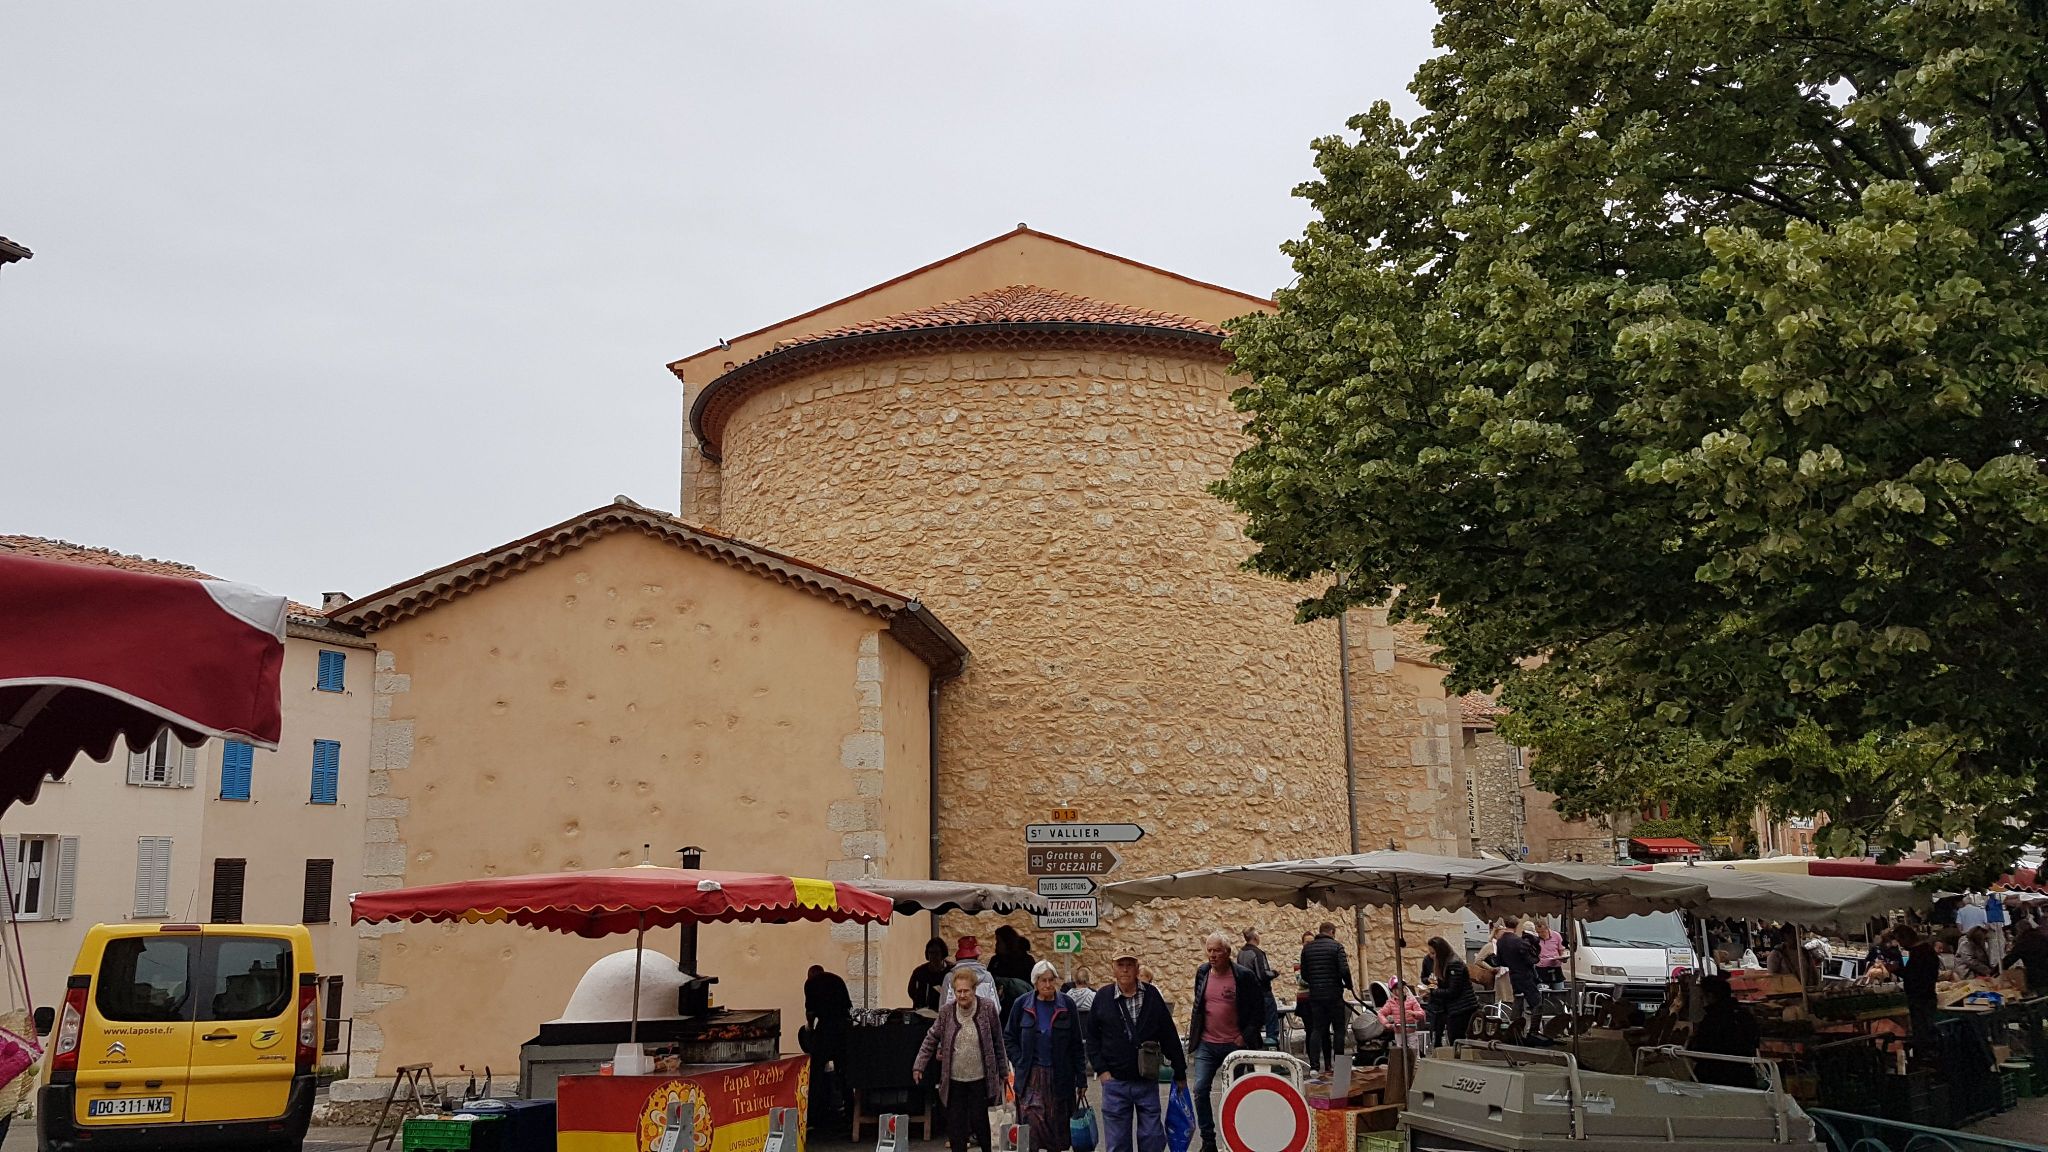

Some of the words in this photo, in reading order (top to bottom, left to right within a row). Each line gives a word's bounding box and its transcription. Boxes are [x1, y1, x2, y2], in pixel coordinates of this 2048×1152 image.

[1466, 779, 1476, 834] BRASSERIE
[1054, 810, 1061, 820] D
[1064, 810, 1076, 819] 13
[1050, 828, 1100, 838] VALLIER
[1046, 850, 1084, 861] Grottes
[1090, 851, 1102, 860] de
[1060, 862, 1103, 872] CEZAIRE
[1040, 882, 1058, 891] TOUTES
[1060, 882, 1087, 890] DIRECTIONS
[1049, 900, 1093, 910] TTENTION
[103, 1026, 175, 1036] www.laposte.fr
[723, 1074, 751, 1096] Papa
[753, 1065, 785, 1087] Paëlla
[732, 1093, 776, 1116] Traiteur
